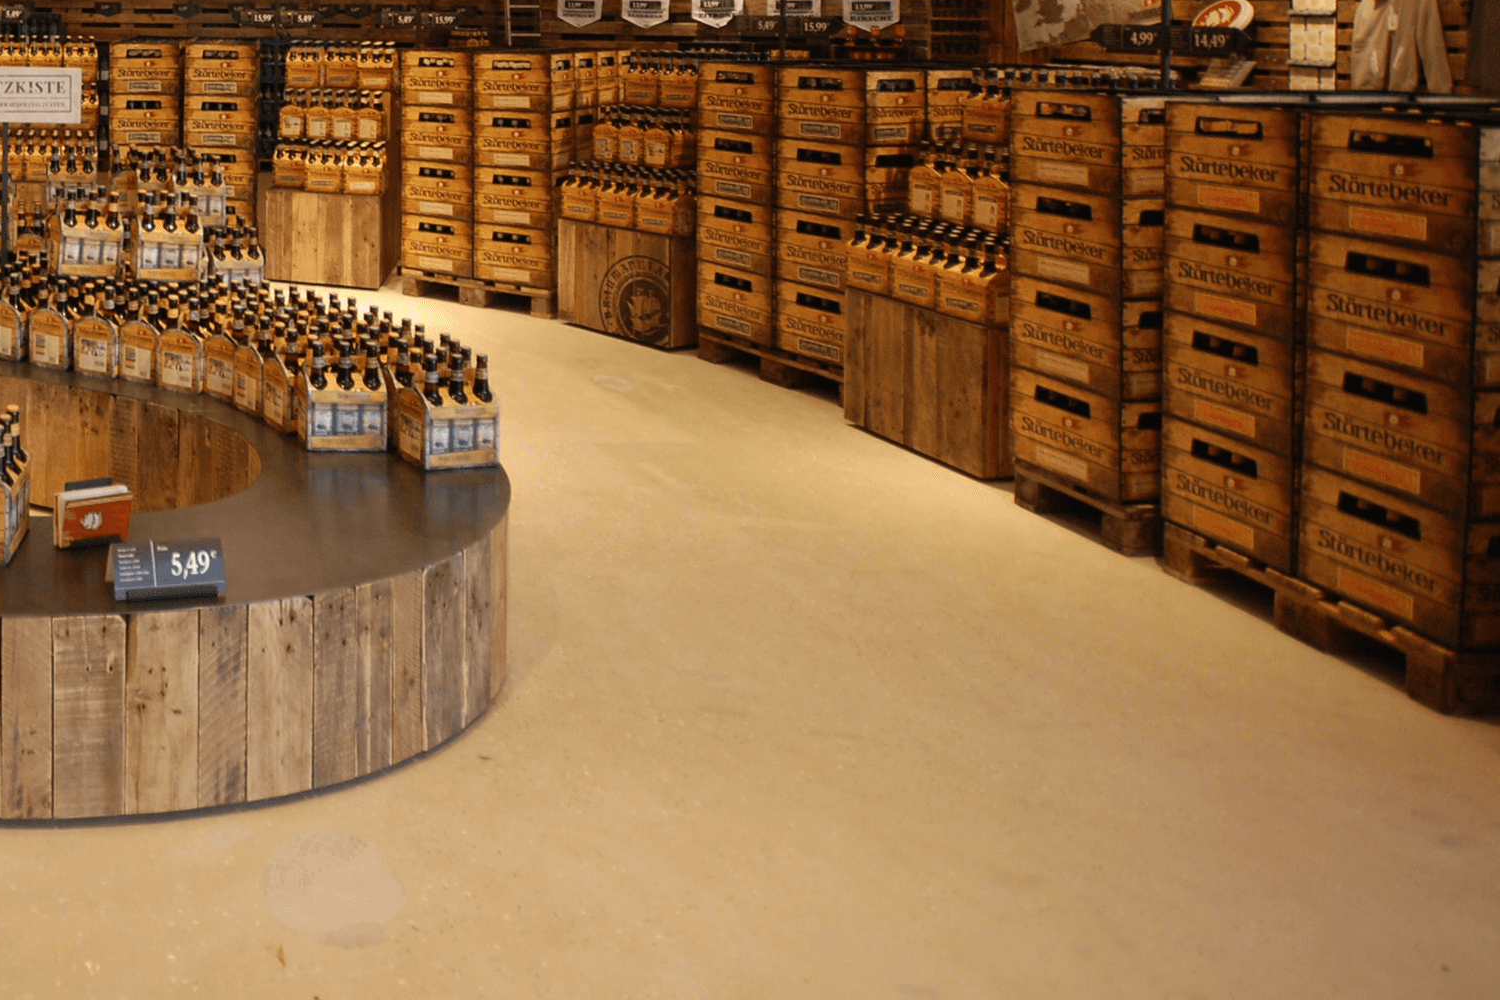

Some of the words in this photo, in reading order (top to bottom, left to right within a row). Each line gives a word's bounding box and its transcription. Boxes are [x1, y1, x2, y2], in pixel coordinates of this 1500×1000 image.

[788, 103, 854, 119] Störtebeker
[1023, 136, 1105, 159] Störtebeker
[786, 174, 853, 194] Störtebeker
[1180, 156, 1279, 183] Störtebeker
[1328, 174, 1452, 207] Störtebeker
[1023, 230, 1105, 260] Störtebeker
[1178, 262, 1276, 297] Störtebeker
[1326, 293, 1449, 337] Störtebeker
[1023, 323, 1105, 359] Störtebeker
[1178, 367, 1275, 411] Störtebeker
[1022, 416, 1103, 456] Störtebeker
[1323, 411, 1445, 466] Störtebeker
[1176, 473, 1273, 526] Störtebeker
[1317, 529, 1436, 593] Störtebeker
